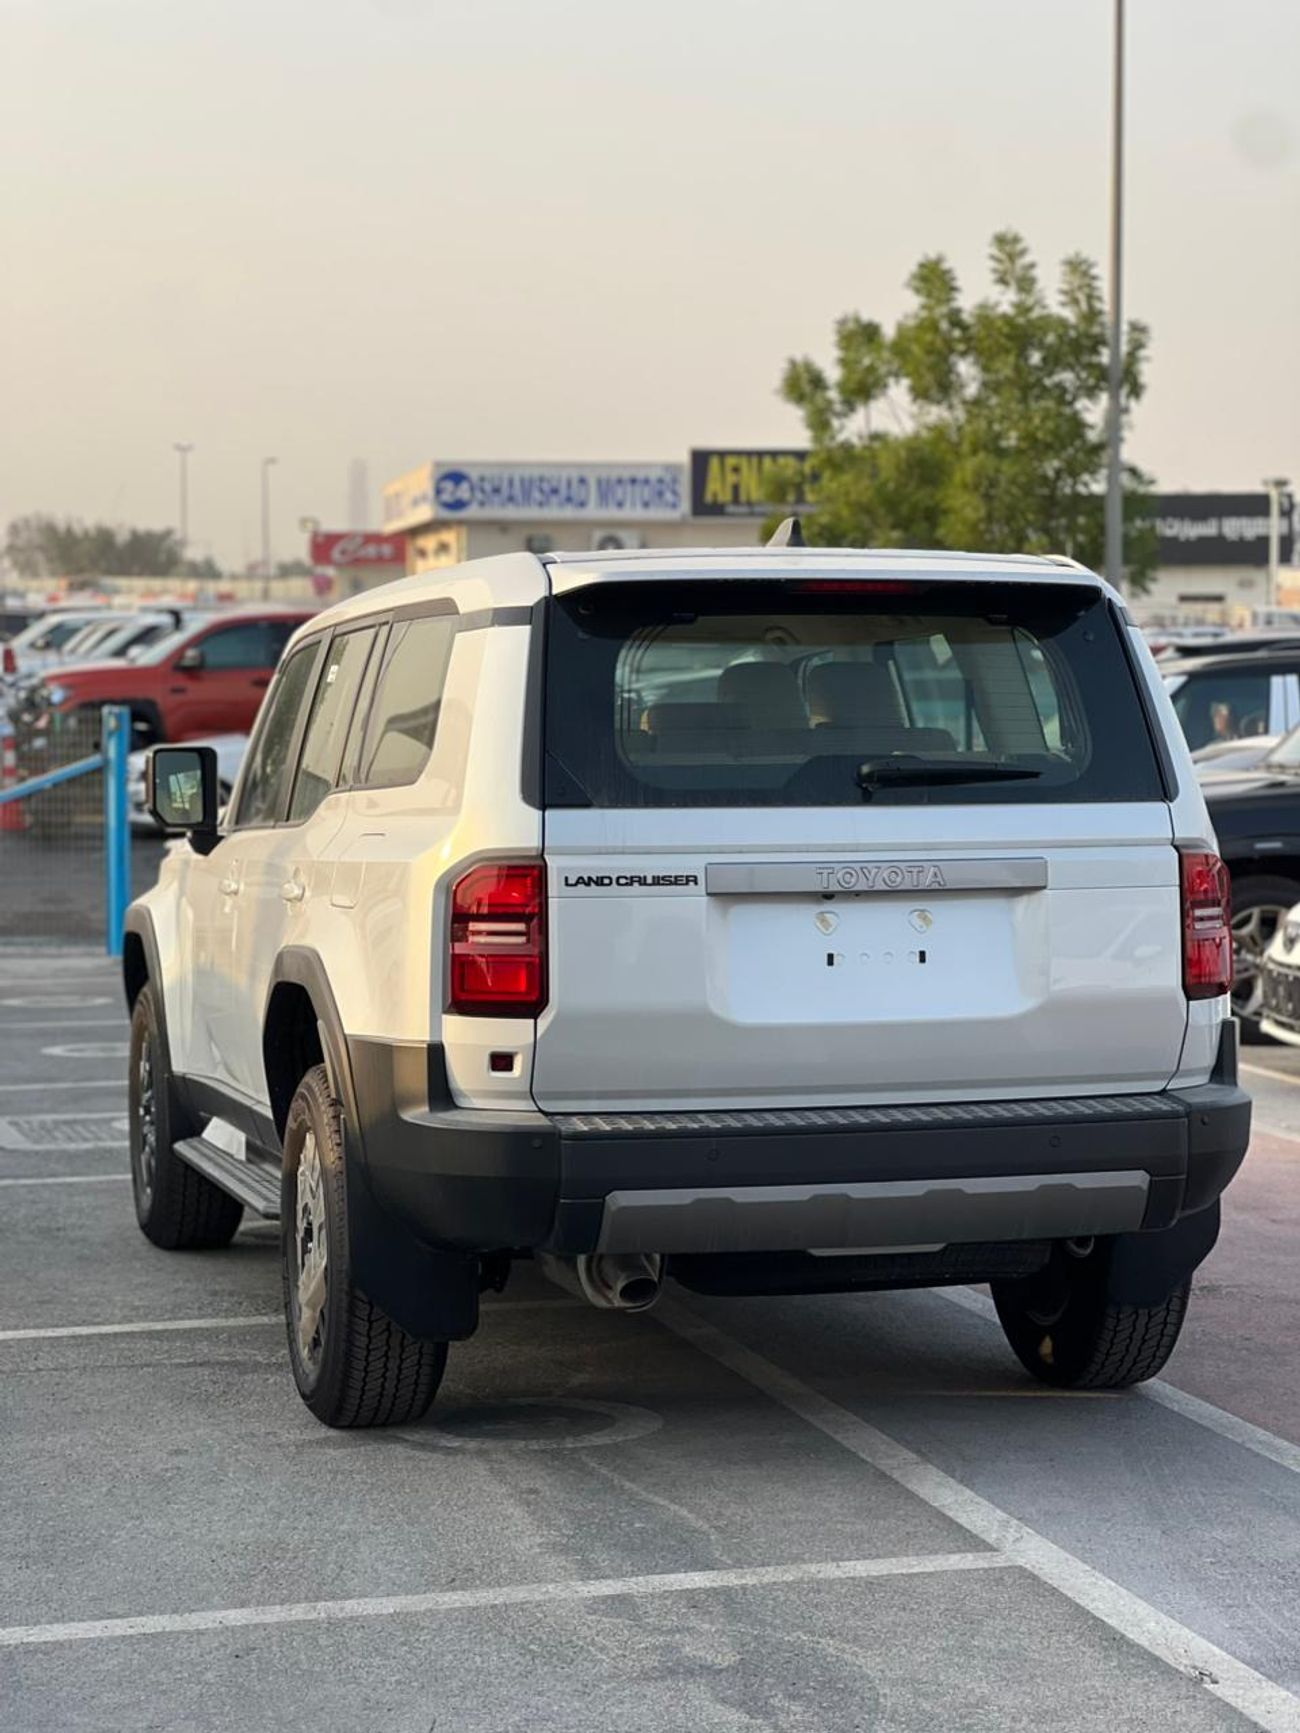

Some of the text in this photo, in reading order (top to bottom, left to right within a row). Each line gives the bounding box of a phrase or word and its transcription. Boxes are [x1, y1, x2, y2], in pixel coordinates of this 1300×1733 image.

[476, 474, 680, 511] SHAMSHAD MOTORS
[564, 874, 699, 887] LAND CRUISER
[816, 865, 946, 889] TOYOTA
